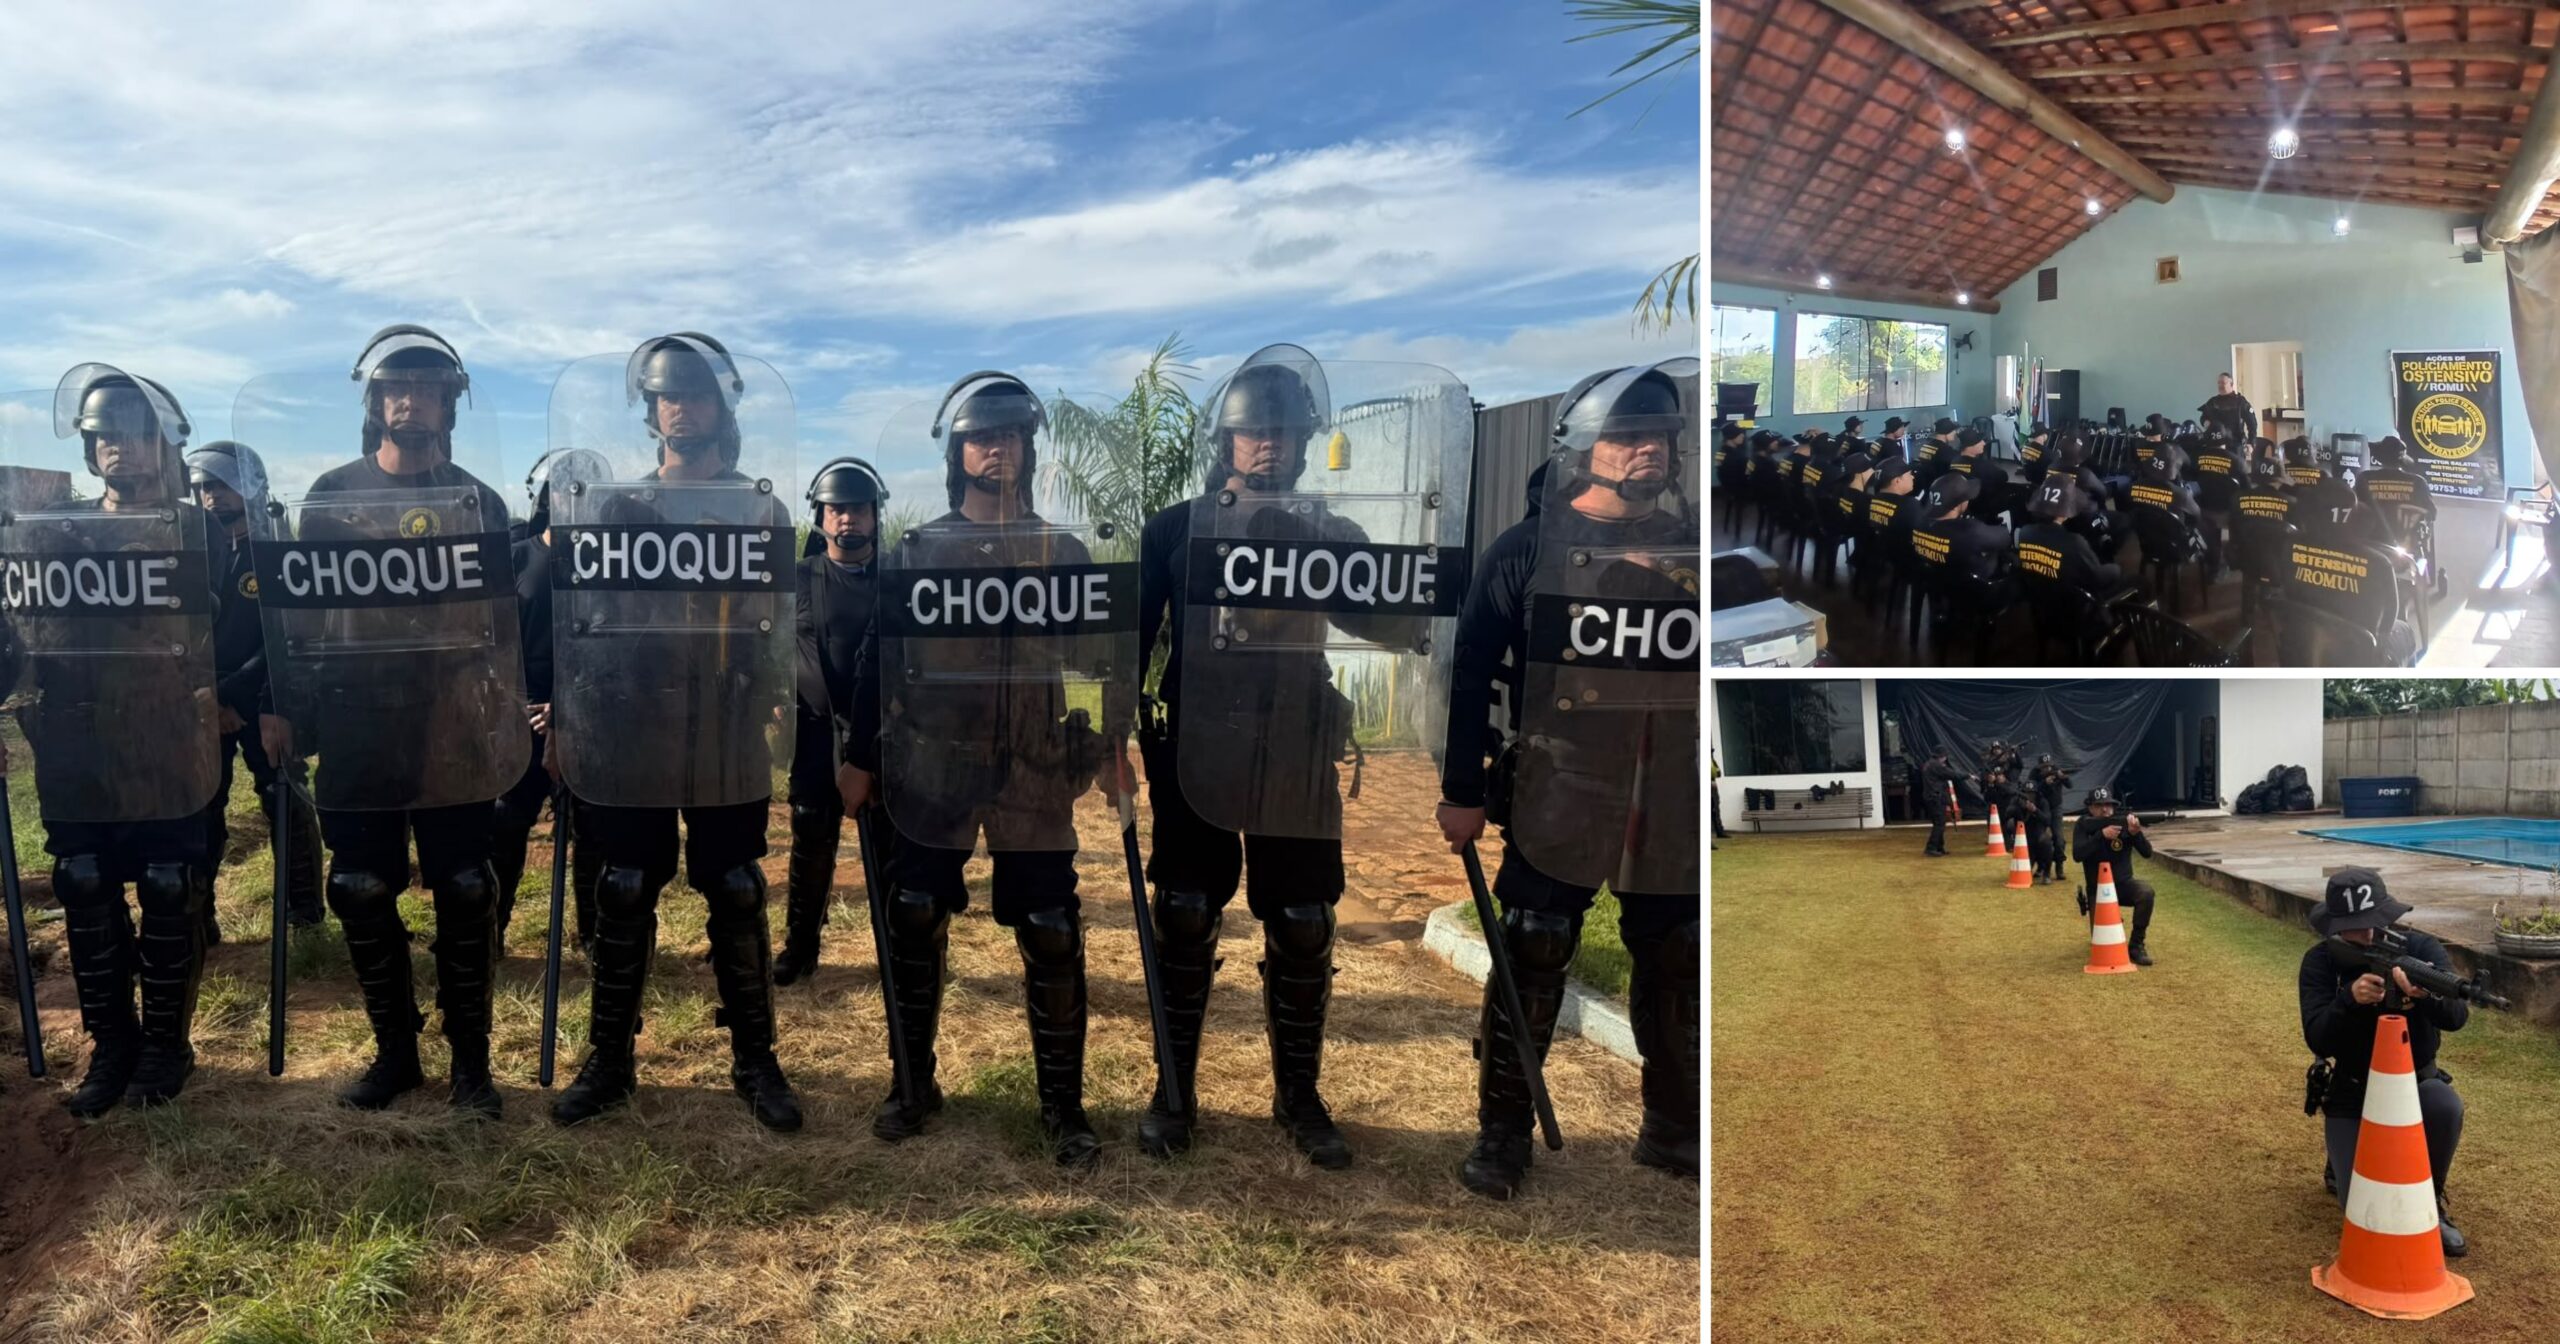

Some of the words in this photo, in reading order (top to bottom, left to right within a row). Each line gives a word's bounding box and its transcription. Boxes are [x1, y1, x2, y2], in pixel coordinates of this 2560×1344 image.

[2401, 361, 2493, 372] POLICIAMENTO
[2425, 354, 2454, 363] AÇÕES
[2402, 370, 2493, 383] OSTENSIVO
[2152, 457, 2165, 470] 25
[2260, 463, 2275, 475] 04
[2044, 487, 2061, 503] 12
[2240, 500, 2288, 512] OSTENSIVO
[2331, 507, 2352, 523] 17
[574, 532, 765, 583] CHOQUE
[2292, 552, 2367, 577] OSTENSIVO
[282, 543, 483, 596] CHOQUE
[1224, 546, 1438, 606] CHOQUE
[6, 558, 171, 608] CHOQUE
[911, 574, 1110, 627] CHOQUE
[1570, 605, 1700, 660] CHO
[2094, 789, 2108, 800] 09
[2342, 884, 2375, 913] 12
